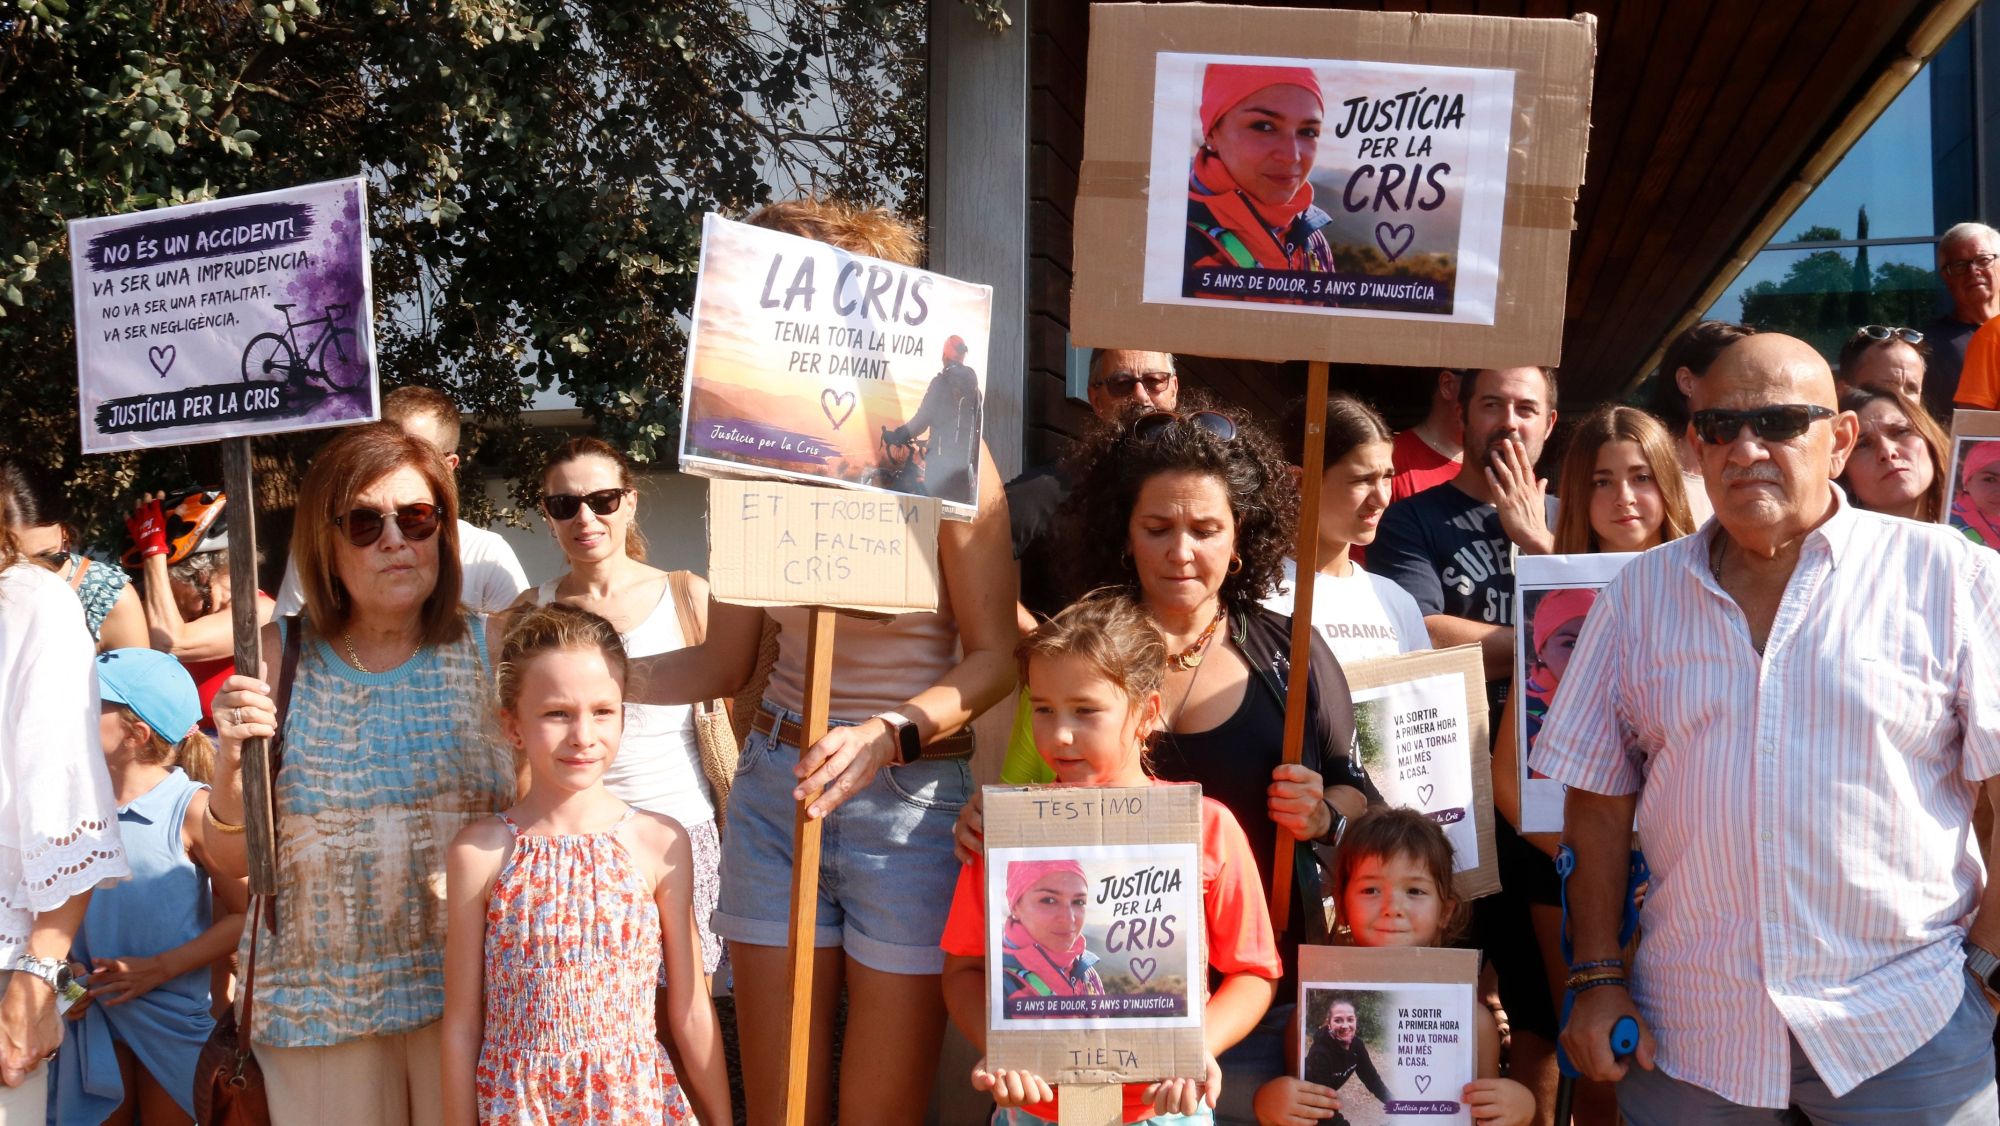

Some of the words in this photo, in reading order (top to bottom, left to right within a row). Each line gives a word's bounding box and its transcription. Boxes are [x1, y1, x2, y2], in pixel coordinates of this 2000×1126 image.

[1335, 87, 1465, 138] JUSTÍCIA
[1357, 137, 1396, 159] PER
[1405, 135, 1432, 157] LA
[1342, 162, 1451, 213] CRIS
[103, 242, 129, 264] NO
[137, 235, 158, 258] ÉS
[165, 236, 189, 256] UN
[196, 218, 294, 251] ACCIDENT!
[92, 279, 114, 297] VA
[121, 274, 151, 294] SER
[156, 268, 189, 287] UNA
[760, 253, 816, 312] LA
[833, 261, 933, 326] CRIS
[1202, 274, 1211, 287] 5
[1214, 275, 1244, 289] ANYS
[1248, 276, 1264, 290] DE
[1268, 278, 1309, 294] DOLOR,
[1312, 280, 1321, 293] 5
[1325, 282, 1356, 296] ANYS
[1360, 282, 1434, 300] D'INJUSTÍCIA
[102, 303, 119, 319] NO
[124, 302, 140, 317] VA
[144, 299, 167, 314] SER
[170, 295, 195, 309] UNA
[201, 285, 271, 307] FATALITAT.
[104, 328, 121, 342] VA
[125, 323, 148, 339] SER
[151, 313, 240, 335] NEGLIGÈNCIA.
[774, 321, 819, 346] TENIA
[829, 326, 863, 349] TOTA
[869, 331, 885, 351] LA
[892, 334, 923, 357] VIDA
[788, 351, 820, 373] PER
[829, 355, 890, 381] DAVANT
[109, 392, 176, 428] JUSTÍCIA
[183, 395, 211, 418] PER
[219, 392, 237, 414] LA
[244, 387, 280, 411] CRIS
[759, 439, 775, 450] per
[781, 436, 791, 450] la
[797, 440, 819, 456] Cris
[742, 493, 782, 521] ET
[811, 500, 919, 524] TROBEM
[778, 530, 795, 549] A
[815, 533, 901, 555] FALTAR
[1442, 539, 1519, 596] SUPE
[1394, 715, 1404, 726] VA
[1407, 708, 1438, 723] SORTIR
[1396, 730, 1400, 739] A
[1402, 722, 1435, 738] PRIMERA
[1437, 718, 1456, 731] HORA
[1397, 745, 1399, 755] I
[1402, 742, 1411, 753] NO
[1414, 739, 1423, 750] VA
[1426, 733, 1457, 748] TORNAR
[1398, 756, 1412, 768] MAI
[1414, 750, 1431, 763] MÉS
[1400, 771, 1404, 781] A
[1407, 765, 1429, 779] CASA.
[1446, 813, 1458, 821] Cris
[1097, 866, 1181, 904] JUSTÍCIA
[1113, 901, 1138, 917] PER
[1145, 898, 1162, 913] LA
[1106, 914, 1176, 953] CRIS
[1016, 1002, 1022, 1011] 5
[1024, 1000, 1044, 1011] ANYS
[1048, 1000, 1058, 1010] DE
[1060, 1000, 1088, 1010] DOLOR,
[1091, 1000, 1097, 1009] 5
[1100, 999, 1120, 1010] ANYS
[1123, 996, 1174, 1009] D'INJUSTÍCIA
[1398, 1009, 1409, 1018] VA
[1412, 1009, 1441, 1018] SORTIR
[1398, 1020, 1403, 1030] A
[1406, 1020, 1437, 1030] PRIMERA
[1440, 1021, 1459, 1030] HORA
[1398, 1034, 1400, 1043] I
[1403, 1034, 1413, 1043] NO
[1416, 1034, 1426, 1043] VA
[1428, 1034, 1458, 1043] TORNAR
[1398, 1045, 1412, 1054] MAI
[1415, 1043, 1432, 1054] MÉS
[1398, 1057, 1403, 1066] A
[1406, 1057, 1428, 1067] CASA.
[1419, 1105, 1429, 1113] per
[1431, 1103, 1438, 1111] la
[1439, 1103, 1451, 1111] Cris
